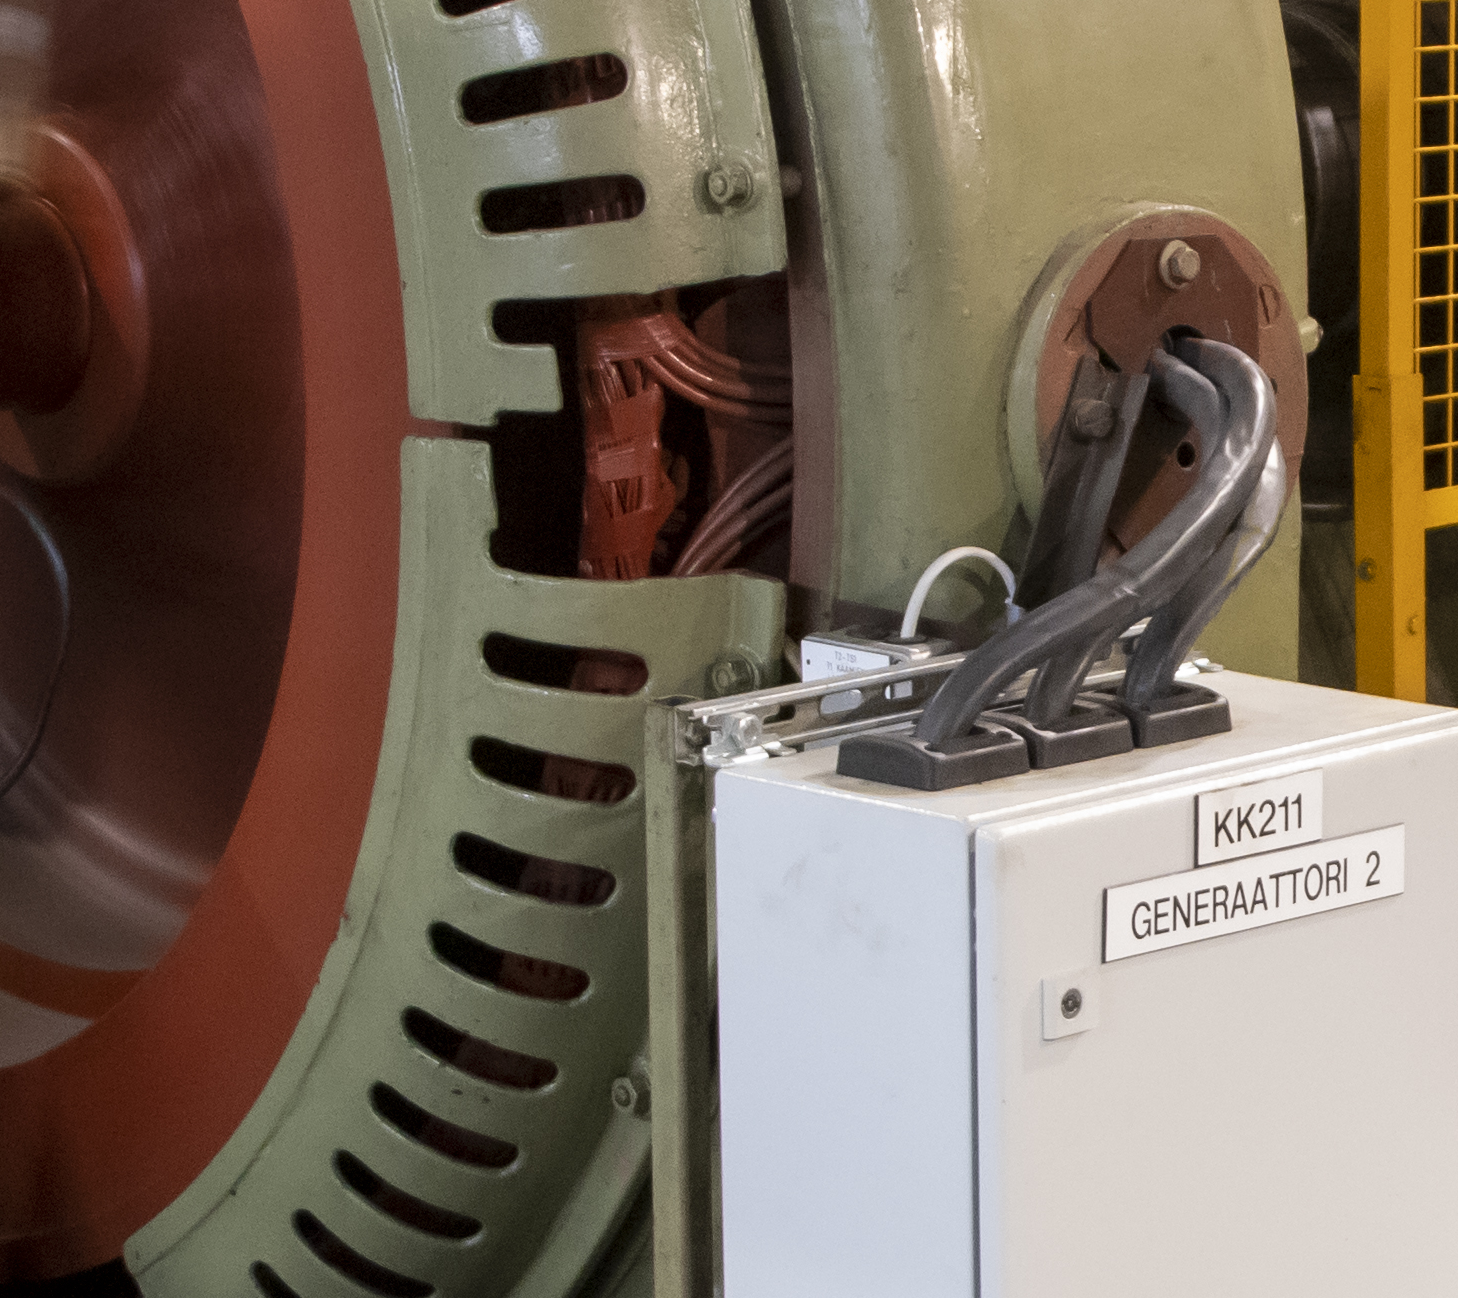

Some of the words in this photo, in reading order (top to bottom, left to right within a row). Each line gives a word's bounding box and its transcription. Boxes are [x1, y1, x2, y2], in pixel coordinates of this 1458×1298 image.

[1214, 792, 1302, 848] KK211
[1131, 857, 1348, 940] GENERAATTORI
[1365, 849, 1381, 888] 2
